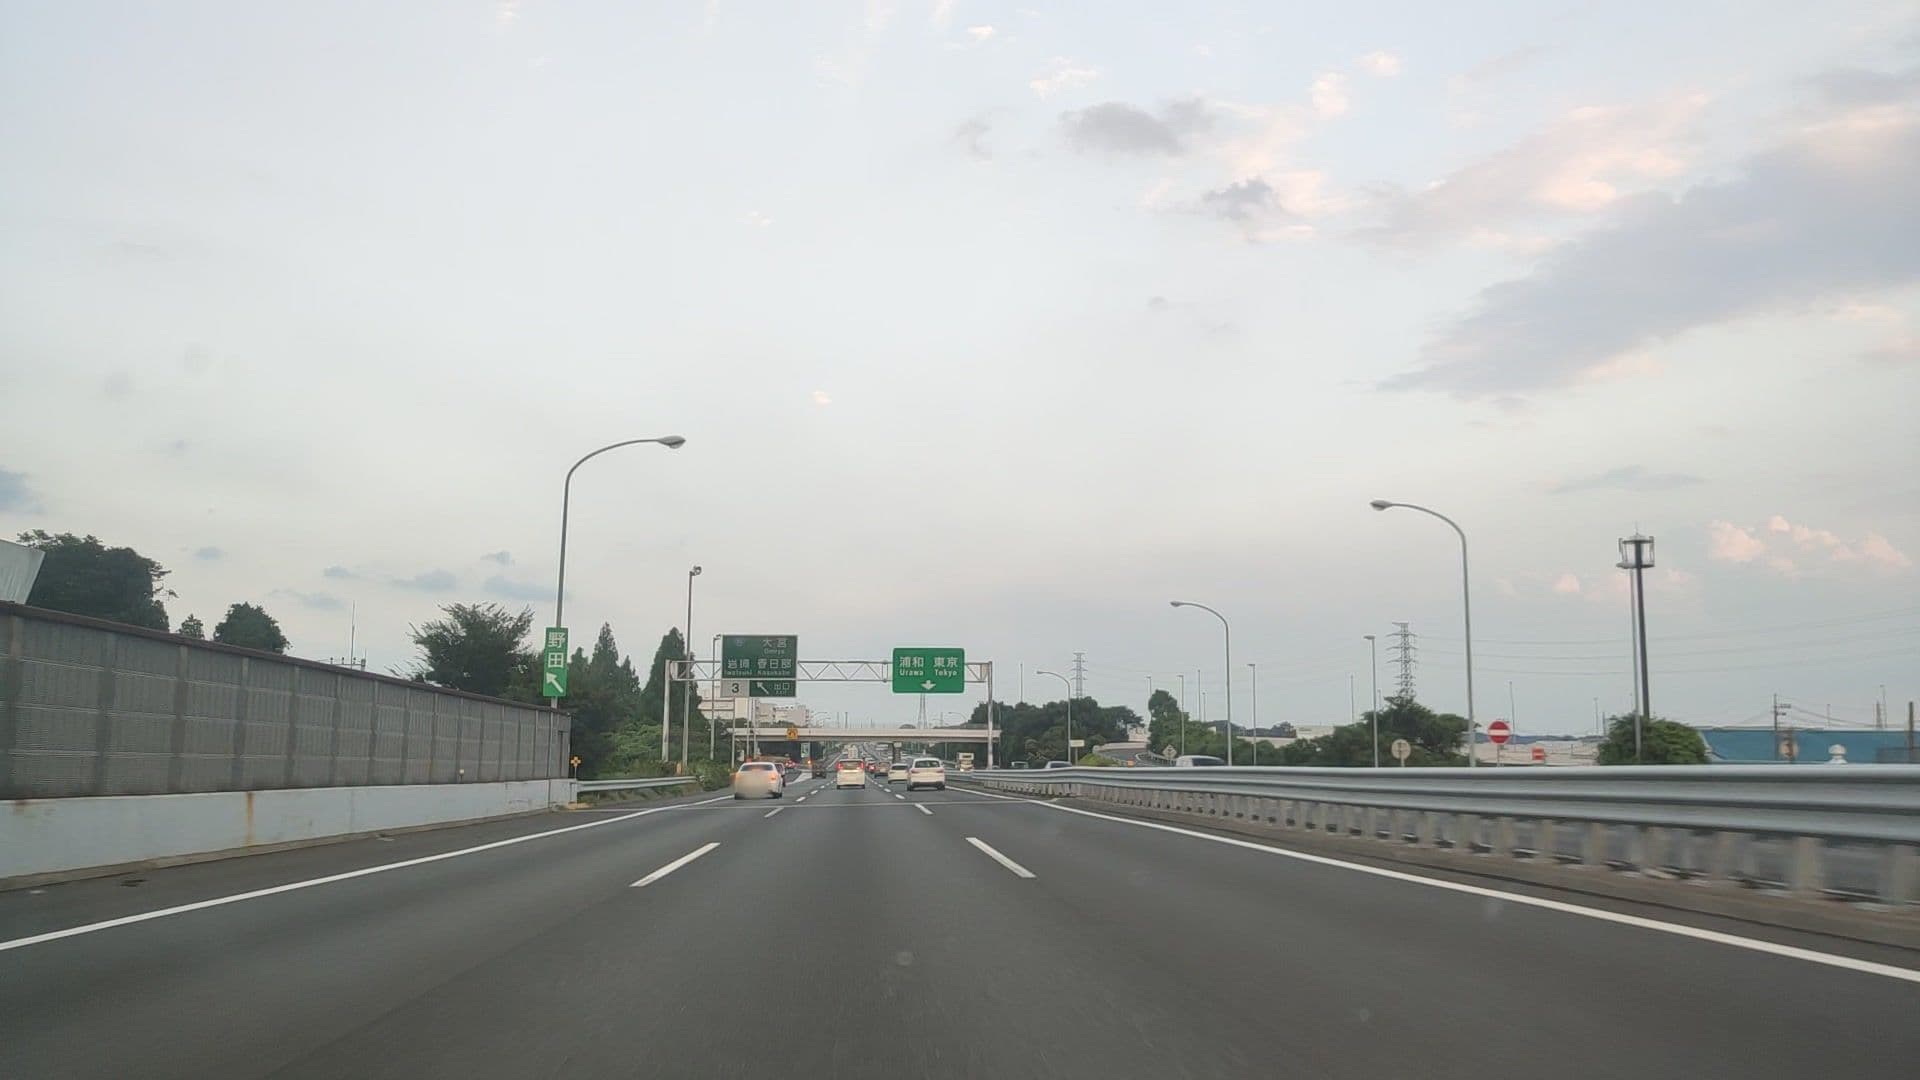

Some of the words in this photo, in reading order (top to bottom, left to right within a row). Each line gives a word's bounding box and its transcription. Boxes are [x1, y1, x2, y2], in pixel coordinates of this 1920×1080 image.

[762, 638, 787, 648] 大宮
[547, 631, 566, 668] 野田
[757, 658, 792, 669] 春日部
[899, 656, 924, 668] 浦和
[933, 656, 959, 668] 東京
[934, 669, 958, 677] Tokyo
[731, 682, 740, 693] 3
[774, 682, 790, 690] 出口
